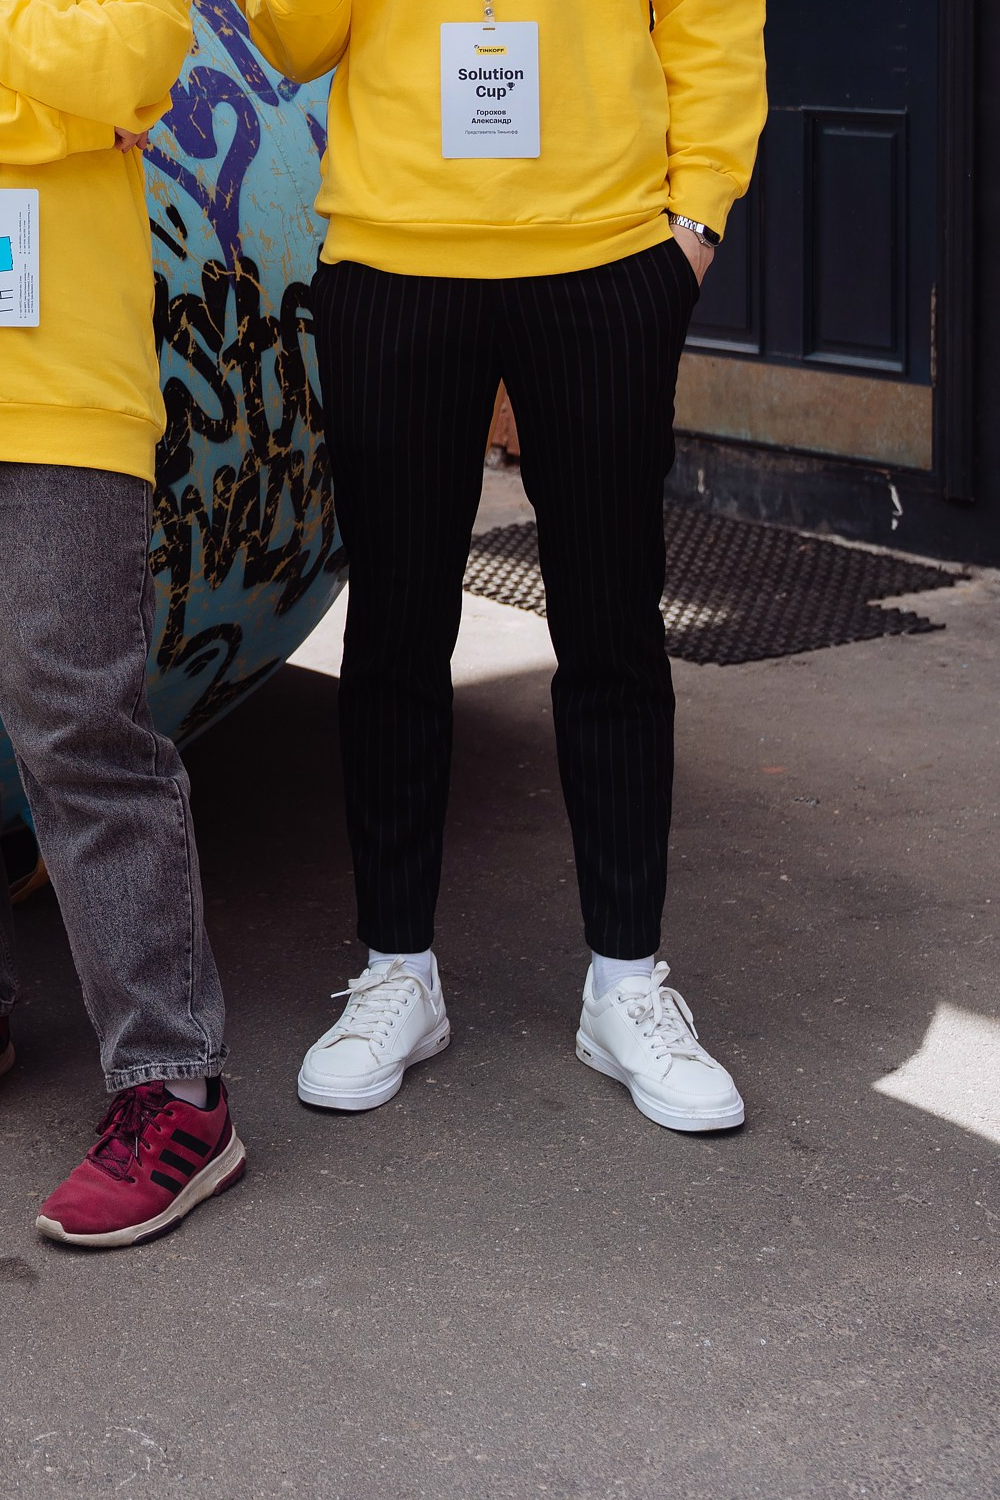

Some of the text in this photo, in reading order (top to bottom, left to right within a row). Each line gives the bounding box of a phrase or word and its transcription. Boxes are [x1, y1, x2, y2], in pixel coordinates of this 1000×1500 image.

[458, 67, 524, 81] Solution
[475, 85, 507, 101] Cup
[476, 109, 507, 117] Горохов
[471, 117, 512, 125] Александр
